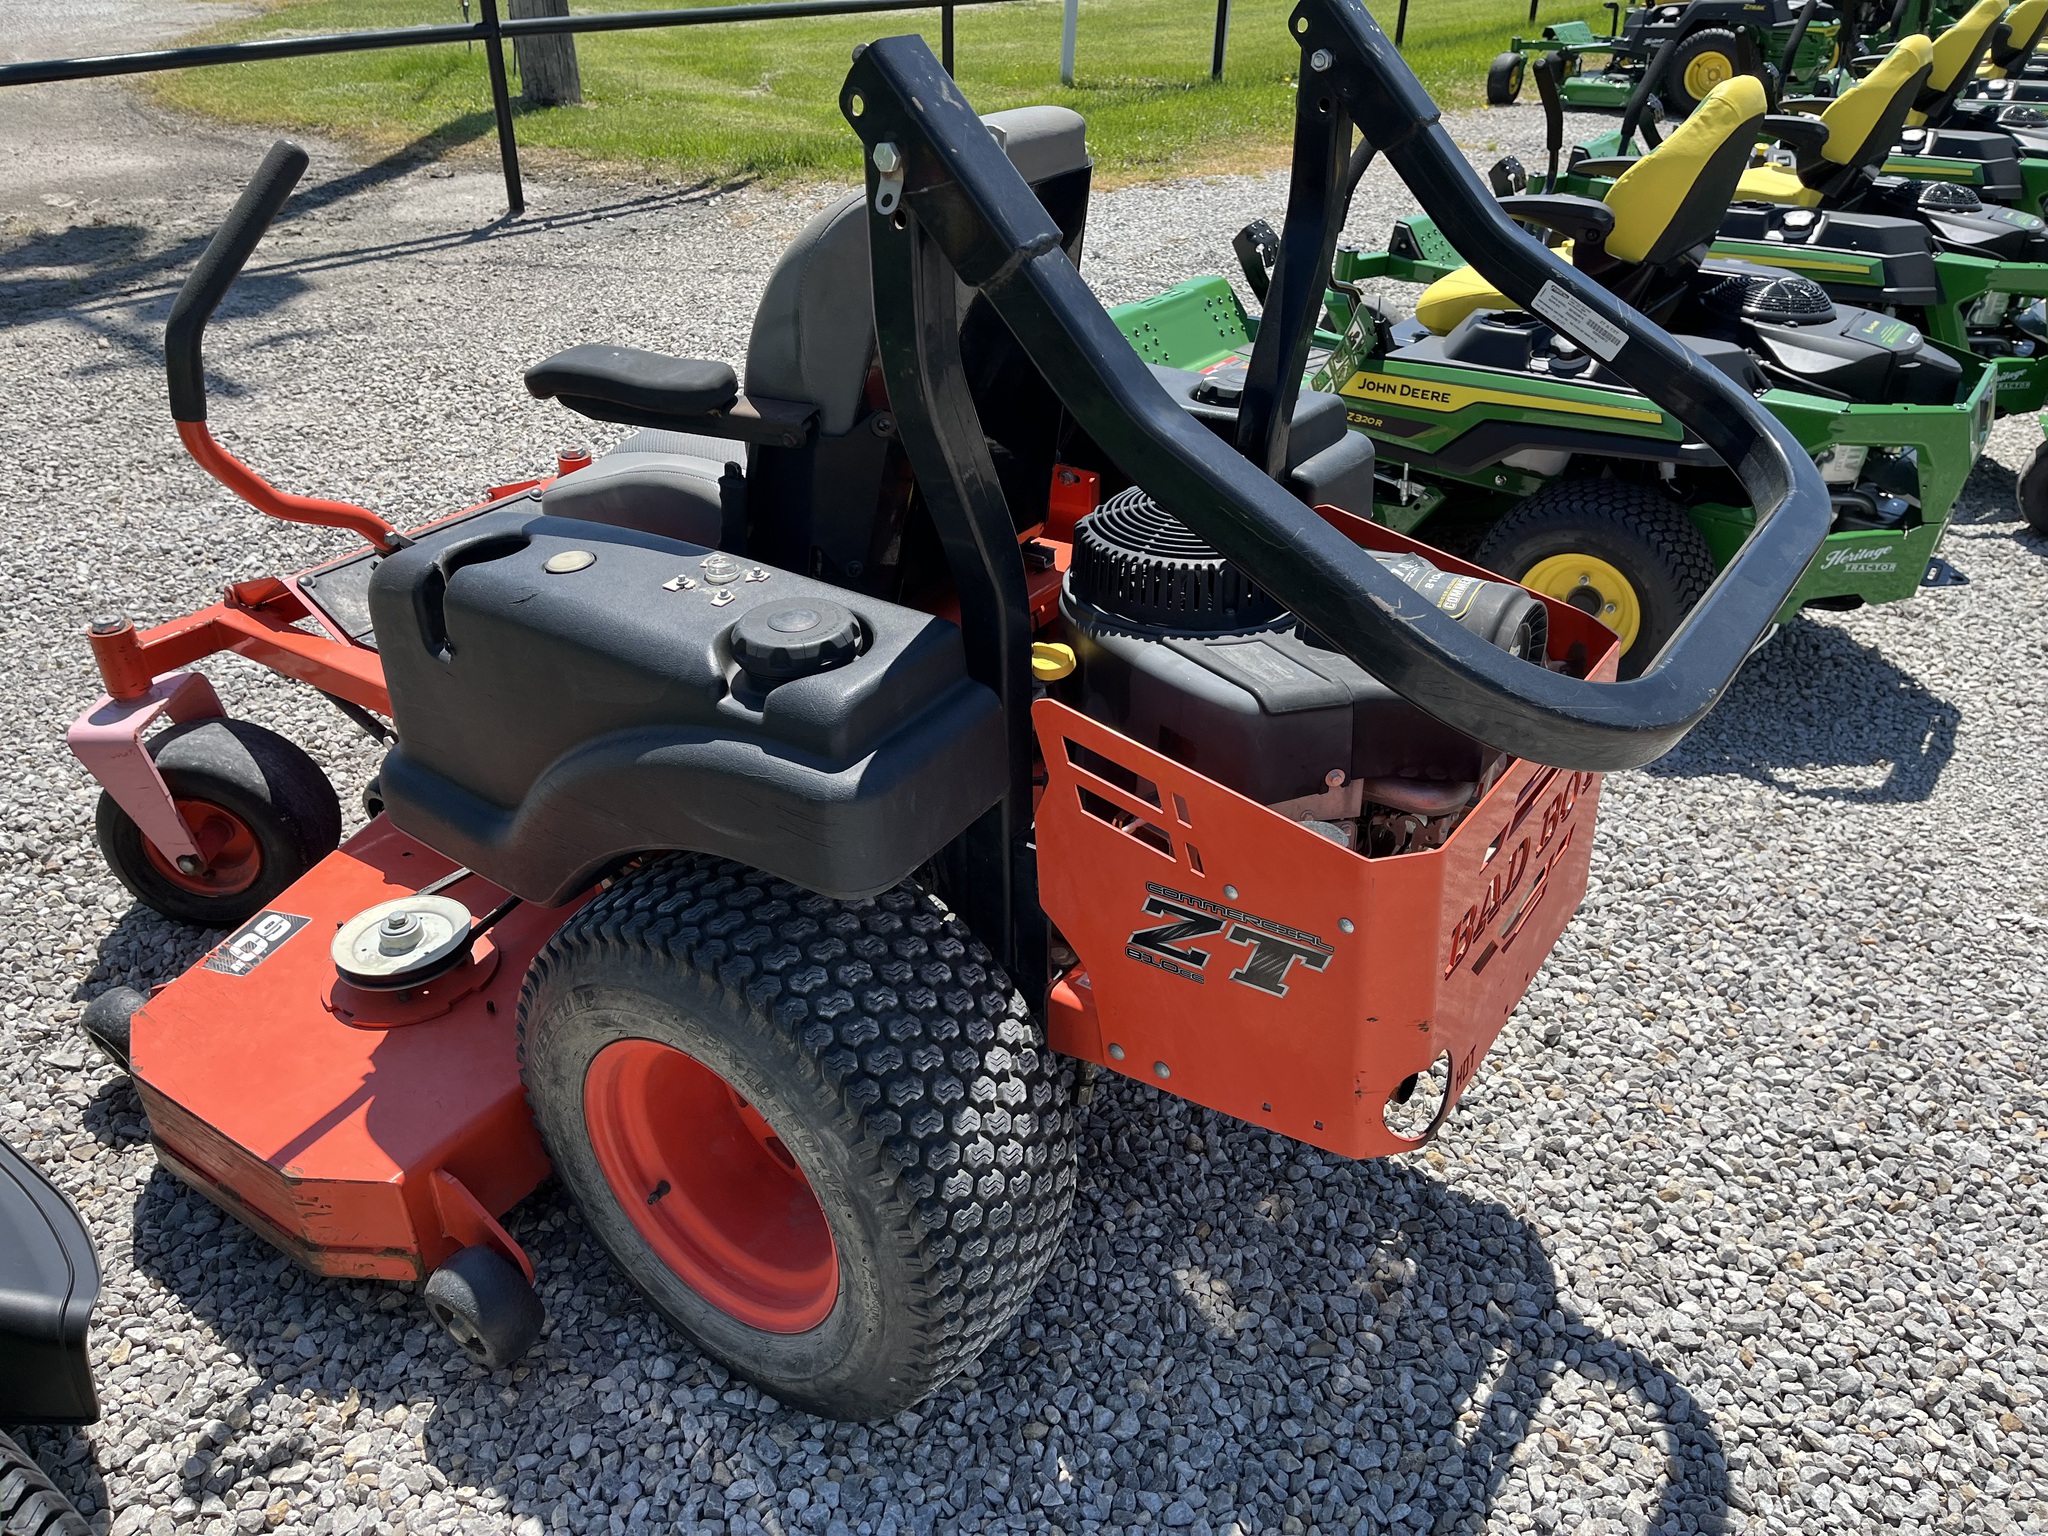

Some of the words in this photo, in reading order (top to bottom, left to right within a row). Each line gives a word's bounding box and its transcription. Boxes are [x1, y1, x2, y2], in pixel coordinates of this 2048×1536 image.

[1358, 378, 1397, 395] JOHN
[1400, 384, 1451, 403] DEERE
[1820, 545, 1893, 570] Heritage
[1843, 562, 1898, 573] TRACTOR
[1145, 881, 1335, 952] COMMERCIAL
[1444, 835, 1531, 981] BAD
[1127, 894, 1334, 999] ZT
[1455, 1044, 1477, 1091] HOT
